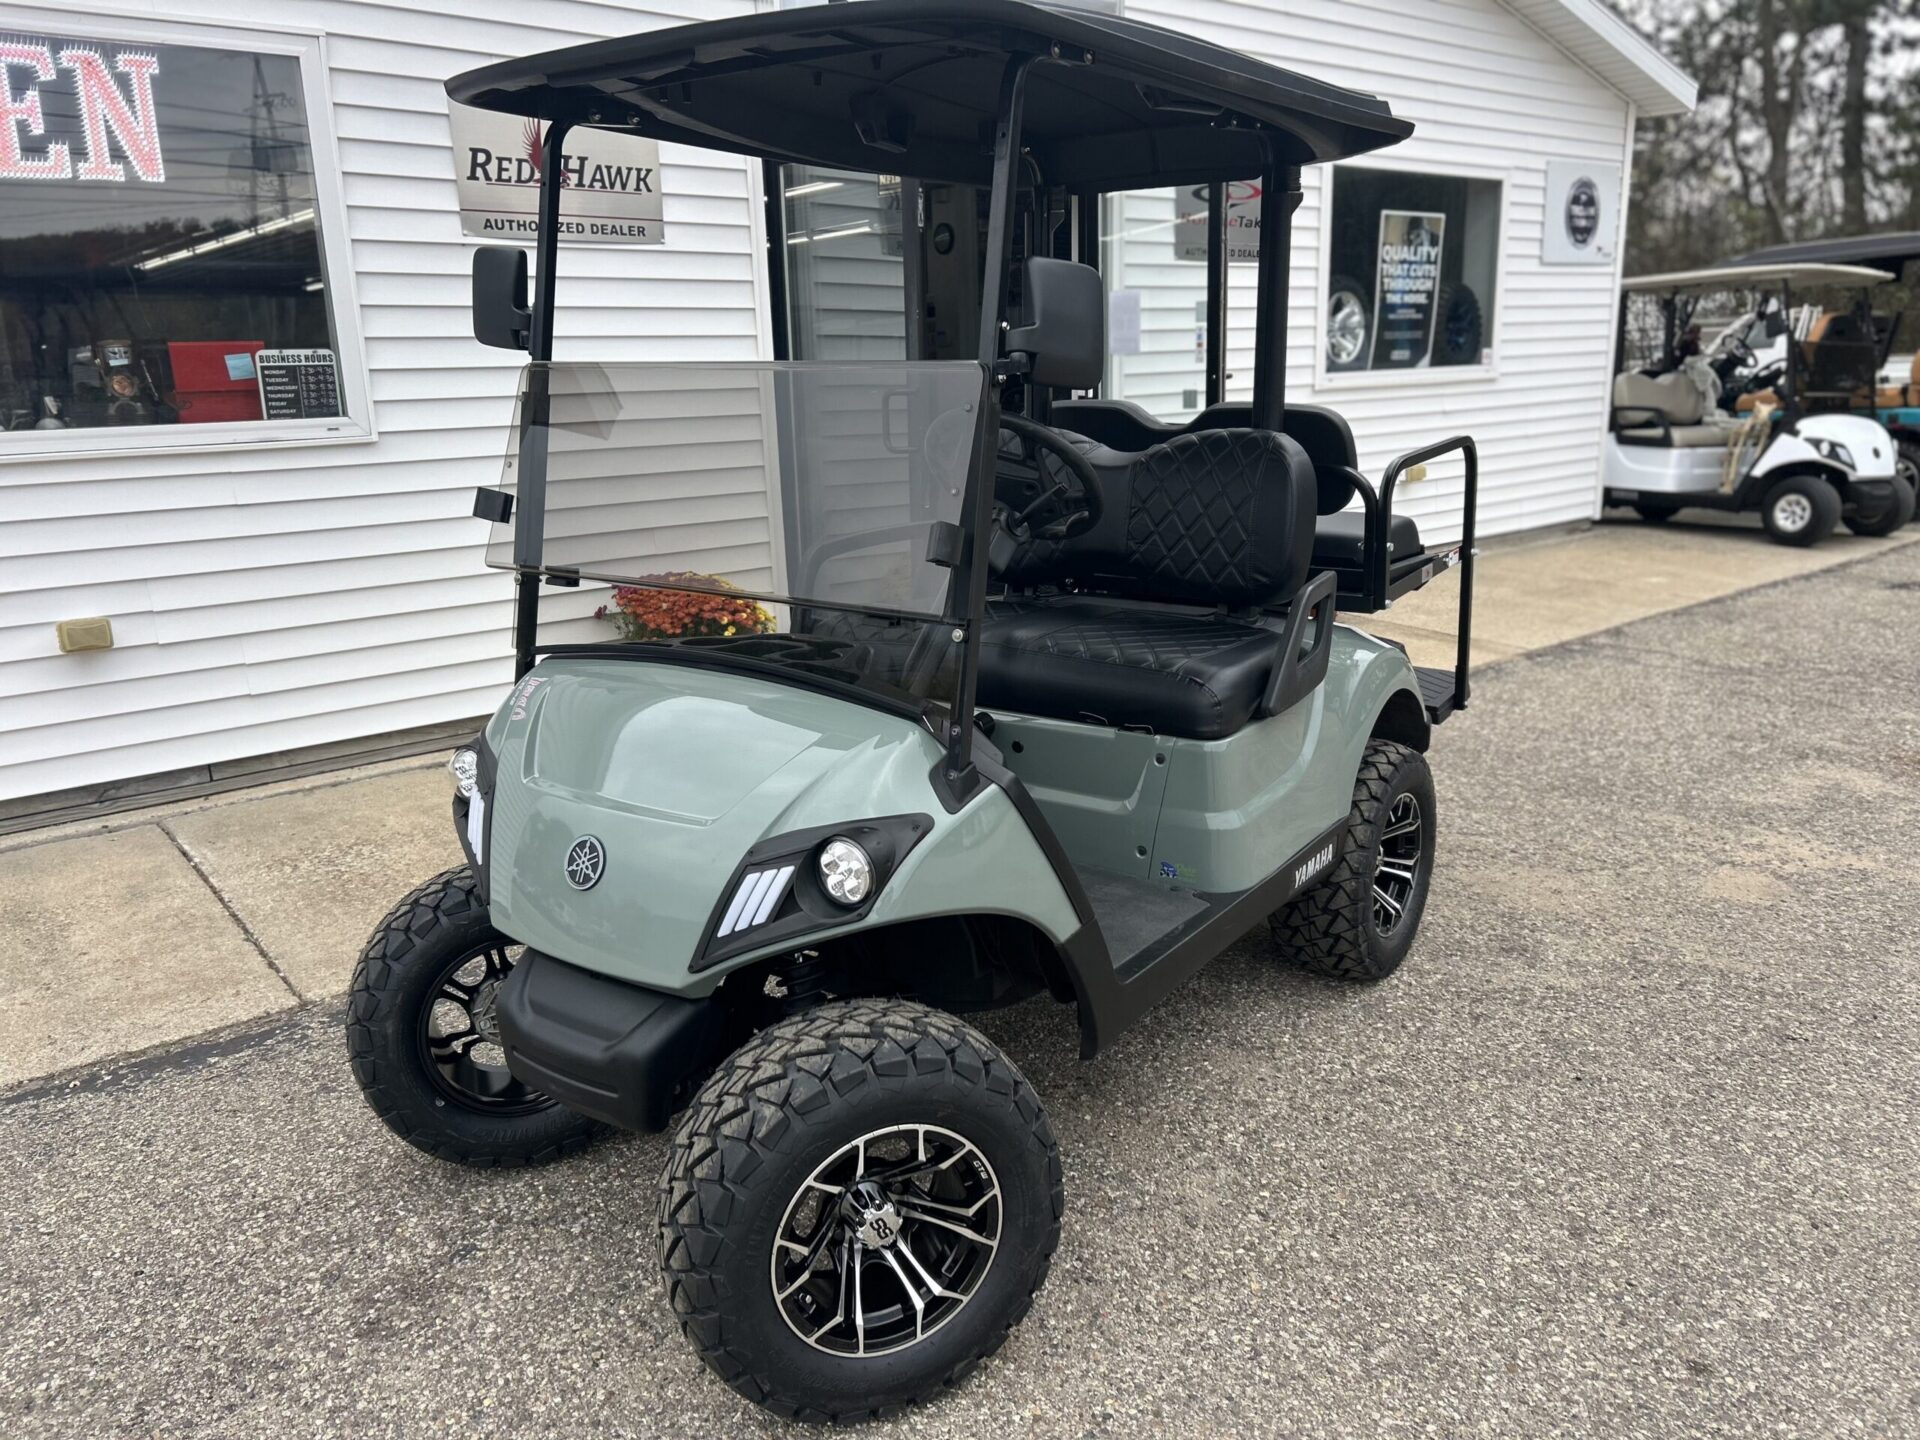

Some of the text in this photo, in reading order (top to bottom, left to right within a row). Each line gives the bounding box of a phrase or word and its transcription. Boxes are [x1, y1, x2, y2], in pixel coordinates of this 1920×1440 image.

[466, 147, 653, 192] RED HAWK
[483, 217, 647, 237] AUTHOZED DEALER
[1237, 248, 1261, 258] DEALE
[1382, 244, 1439, 263] QUALITY
[1382, 263, 1436, 278] THAT CUTS
[258, 353, 334, 364] BUSINESS HOURS
[1294, 843, 1333, 889] YAMAHA
